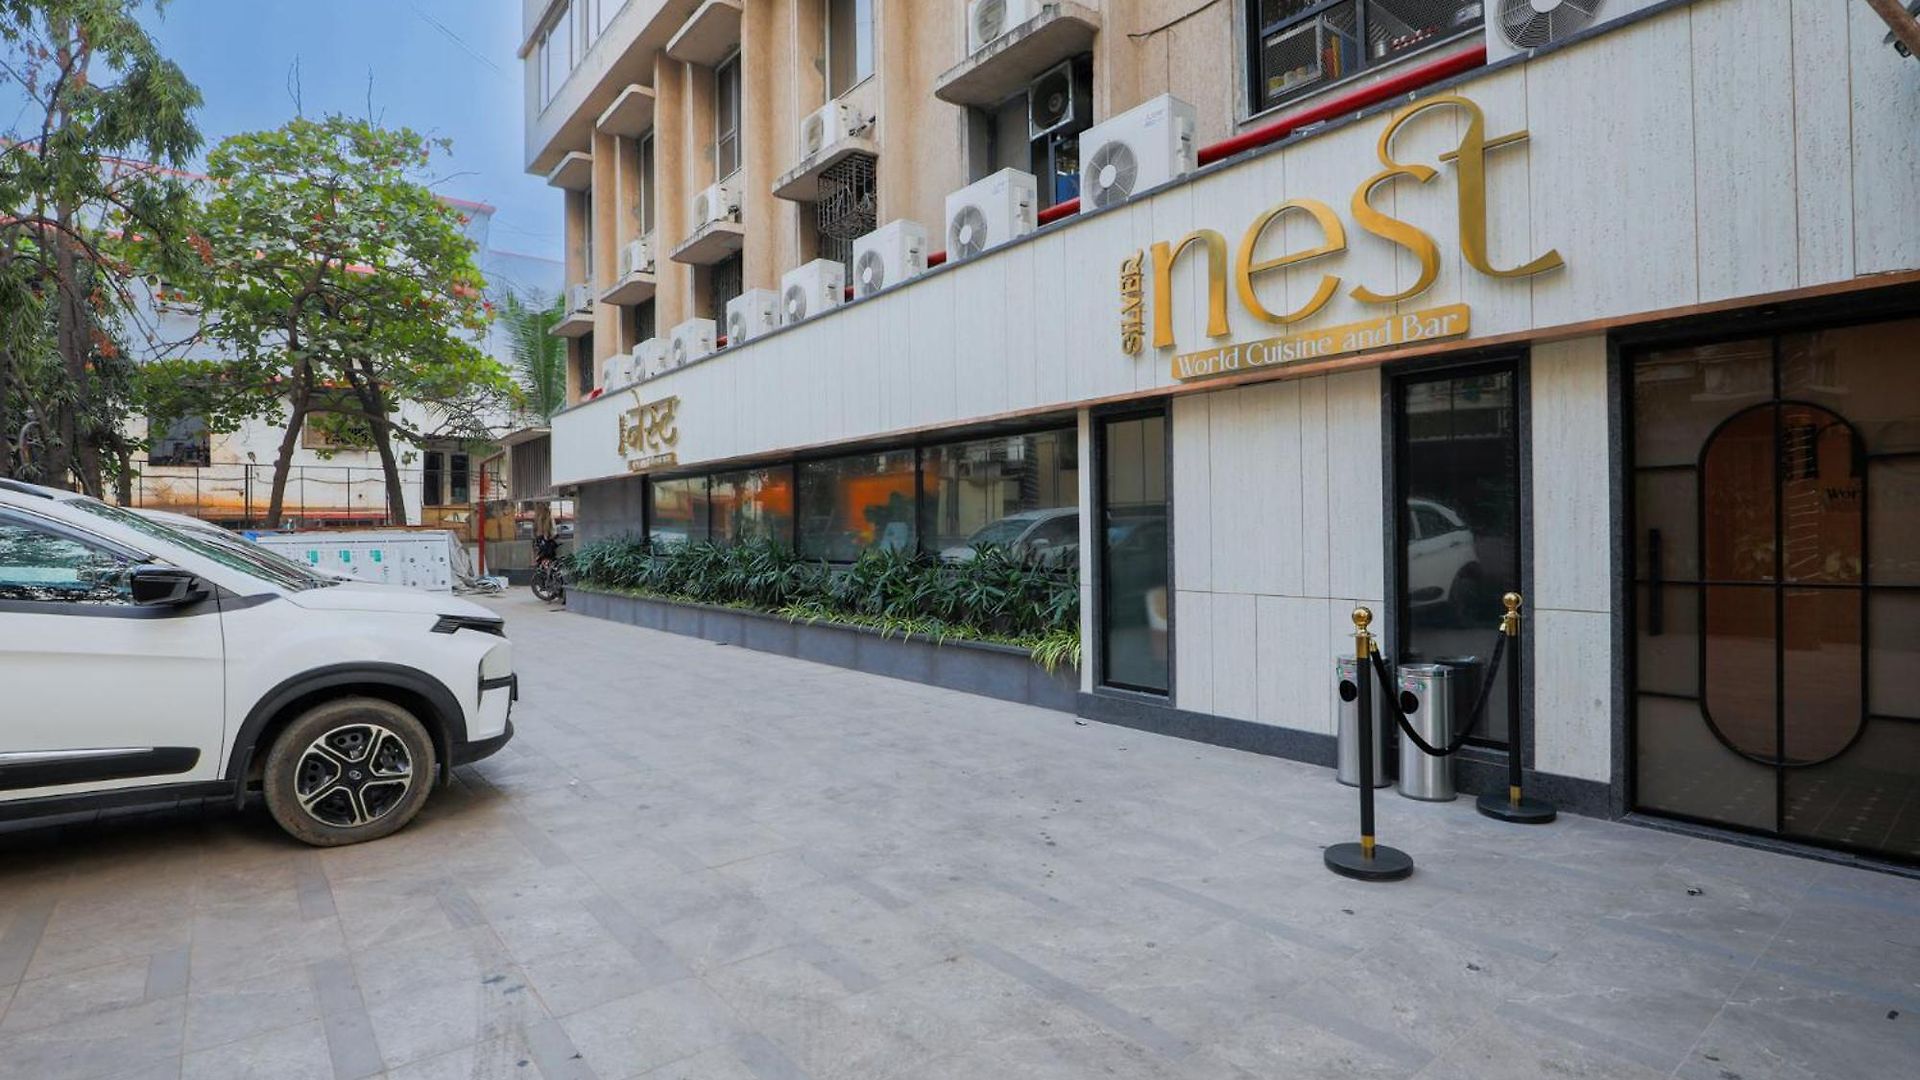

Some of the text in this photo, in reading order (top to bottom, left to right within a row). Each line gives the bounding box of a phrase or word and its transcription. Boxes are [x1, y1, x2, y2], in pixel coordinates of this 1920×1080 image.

[1151, 95, 1566, 349] nest
[1120, 248, 1144, 357] SILVER
[1177, 312, 1459, 377] World Cuisine and Bar
